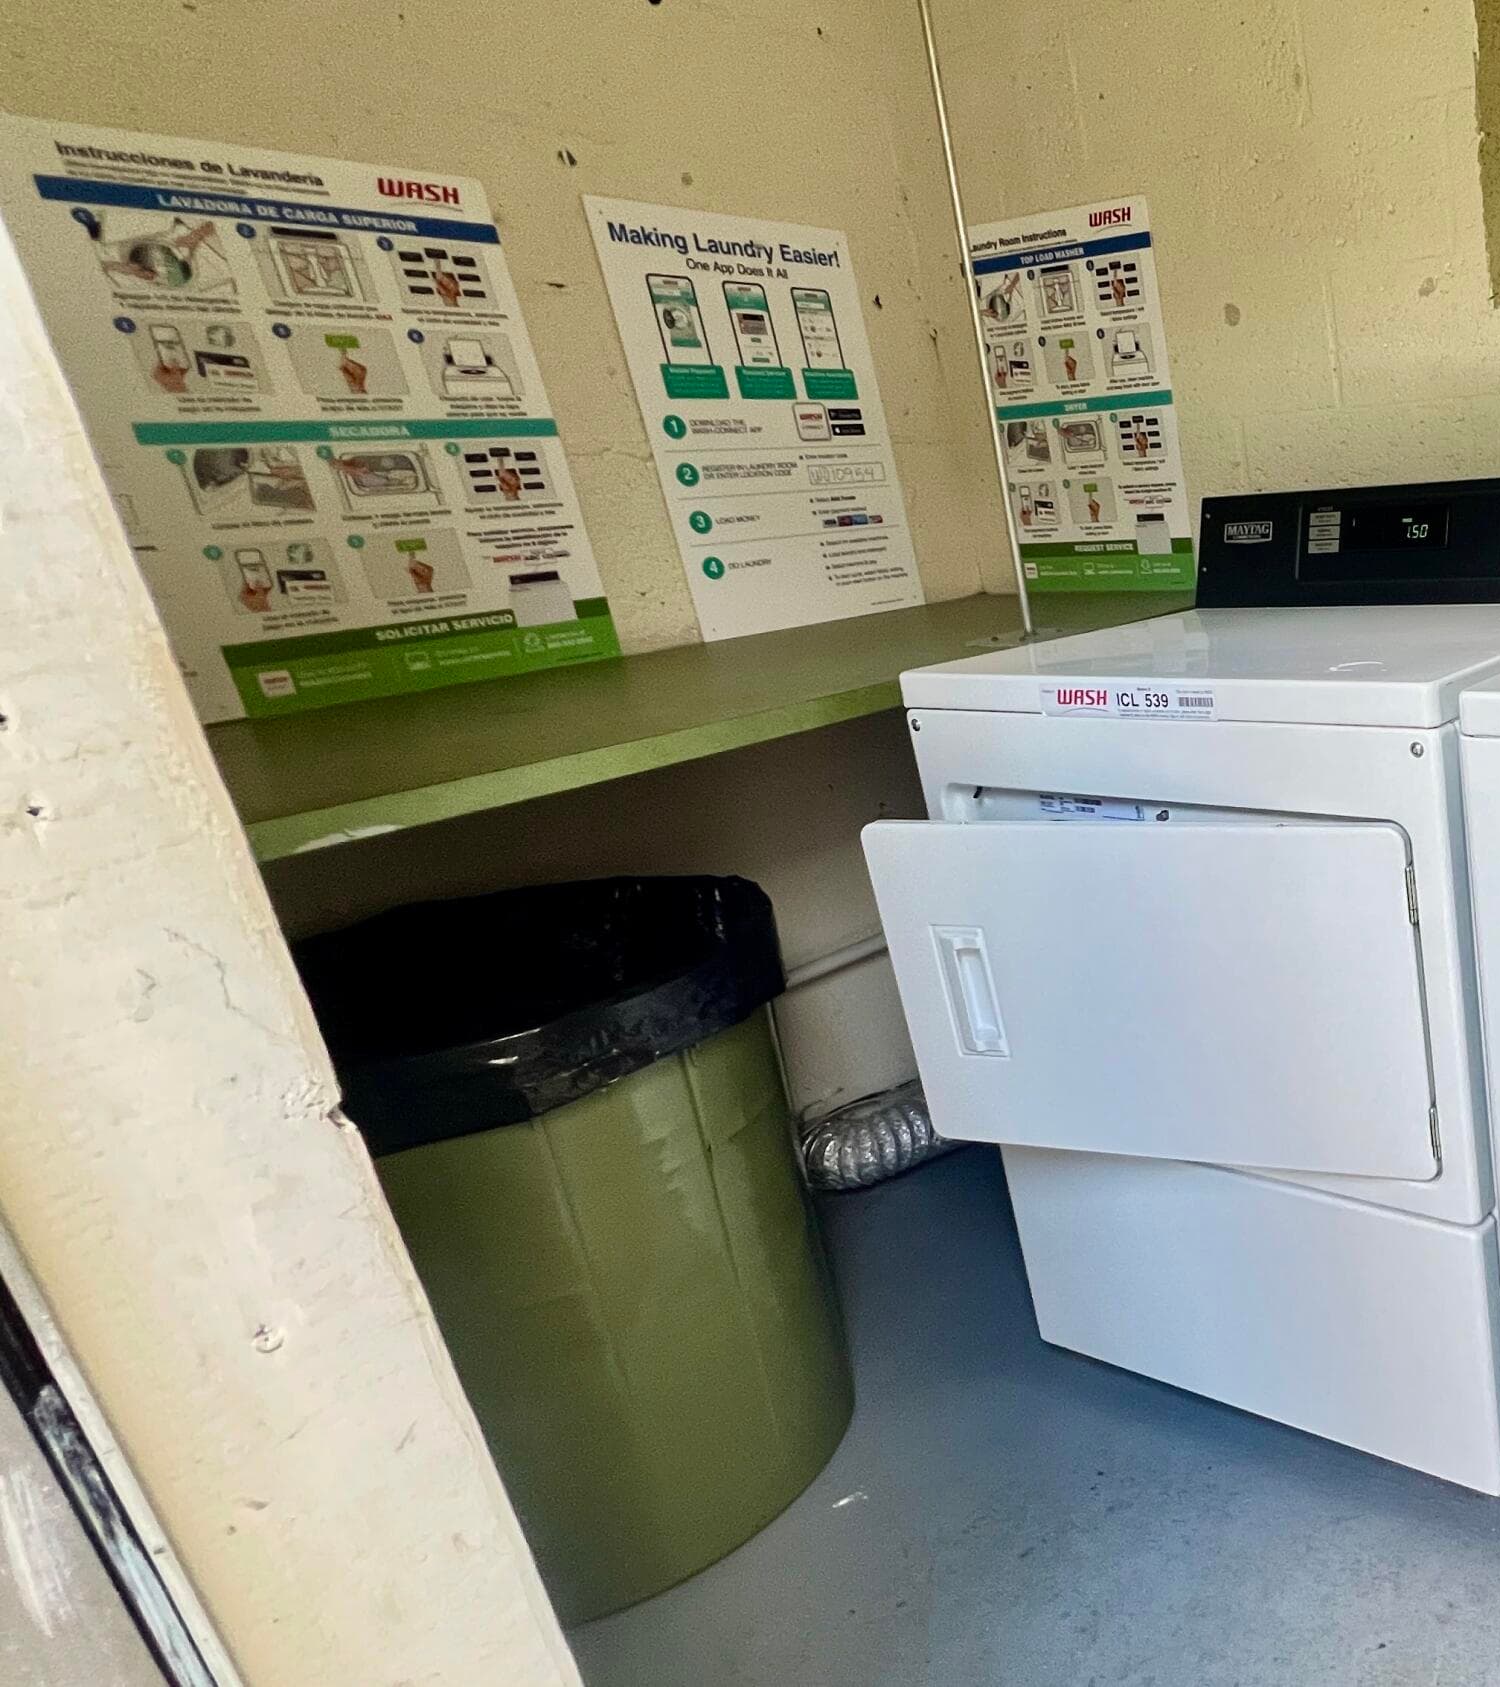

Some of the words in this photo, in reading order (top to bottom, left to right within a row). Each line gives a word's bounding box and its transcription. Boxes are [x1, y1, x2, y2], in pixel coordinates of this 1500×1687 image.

[55, 141, 195, 170] Instrucciones
[200, 160, 223, 174] de
[377, 177, 460, 204] WASH
[156, 194, 252, 215] LAVADORA
[257, 204, 280, 219] DE
[282, 207, 338, 225] CARGA
[342, 214, 419, 233] SUPERIOR
[1089, 207, 1131, 228] WASH
[607, 221, 689, 255] Making
[692, 233, 774, 264] Laundry
[779, 244, 840, 268] Easier!
[971, 240, 998, 251] aundry
[999, 236, 1021, 247] Room
[1021, 228, 1068, 243] Instructions
[1020, 255, 1034, 265] TOP
[1035, 252, 1054, 263] LOAD
[1054, 247, 1085, 260] WASHER
[686, 258, 710, 272] One
[713, 260, 735, 276] App
[737, 263, 765, 277] Does
[775, 268, 788, 280] All
[1227, 523, 1270, 536] MAYTAG
[741, 559, 772, 569] LAUNDRY
[374, 621, 450, 641] SOLICITAR
[453, 613, 513, 631] SERVICIO
[1057, 689, 1107, 706] WASH
[1116, 692, 1139, 707] ICL
[1145, 693, 1169, 708] 539
